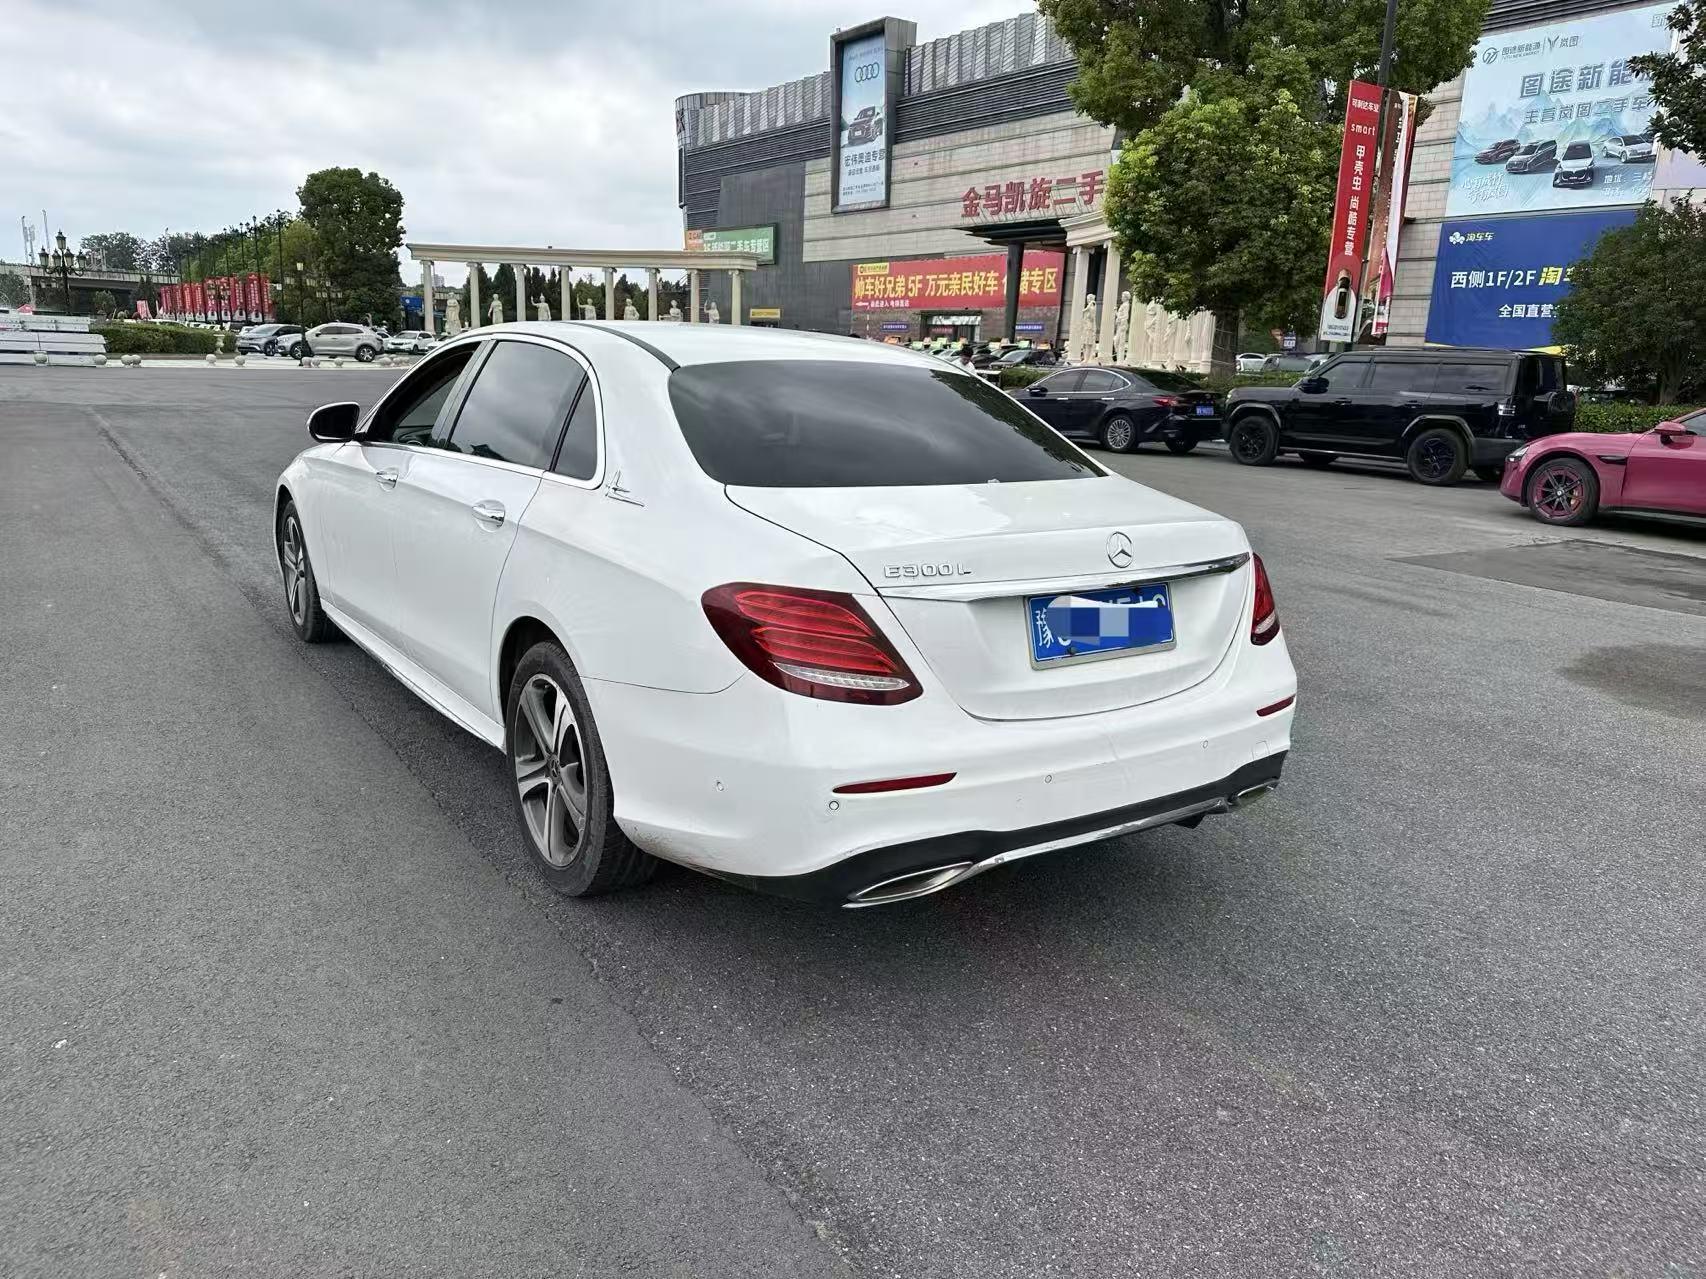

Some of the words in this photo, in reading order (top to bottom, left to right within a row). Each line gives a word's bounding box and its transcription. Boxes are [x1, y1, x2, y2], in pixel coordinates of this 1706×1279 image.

[1520, 59, 1650, 99] 图途新能
[1523, 95, 1648, 125] 主营岚图二手车
[1350, 123, 1376, 136] smart
[961, 170, 1104, 218] 金马凯旋二手
[1466, 231, 1495, 242] 淘车车
[855, 274, 906, 300] 帅车好兄弟
[908, 274, 923, 297] 5F
[925, 270, 999, 297] 万元亲民好车
[1450, 269, 1537, 289] 西侧1F/2F
[883, 562, 972, 579] E300L
